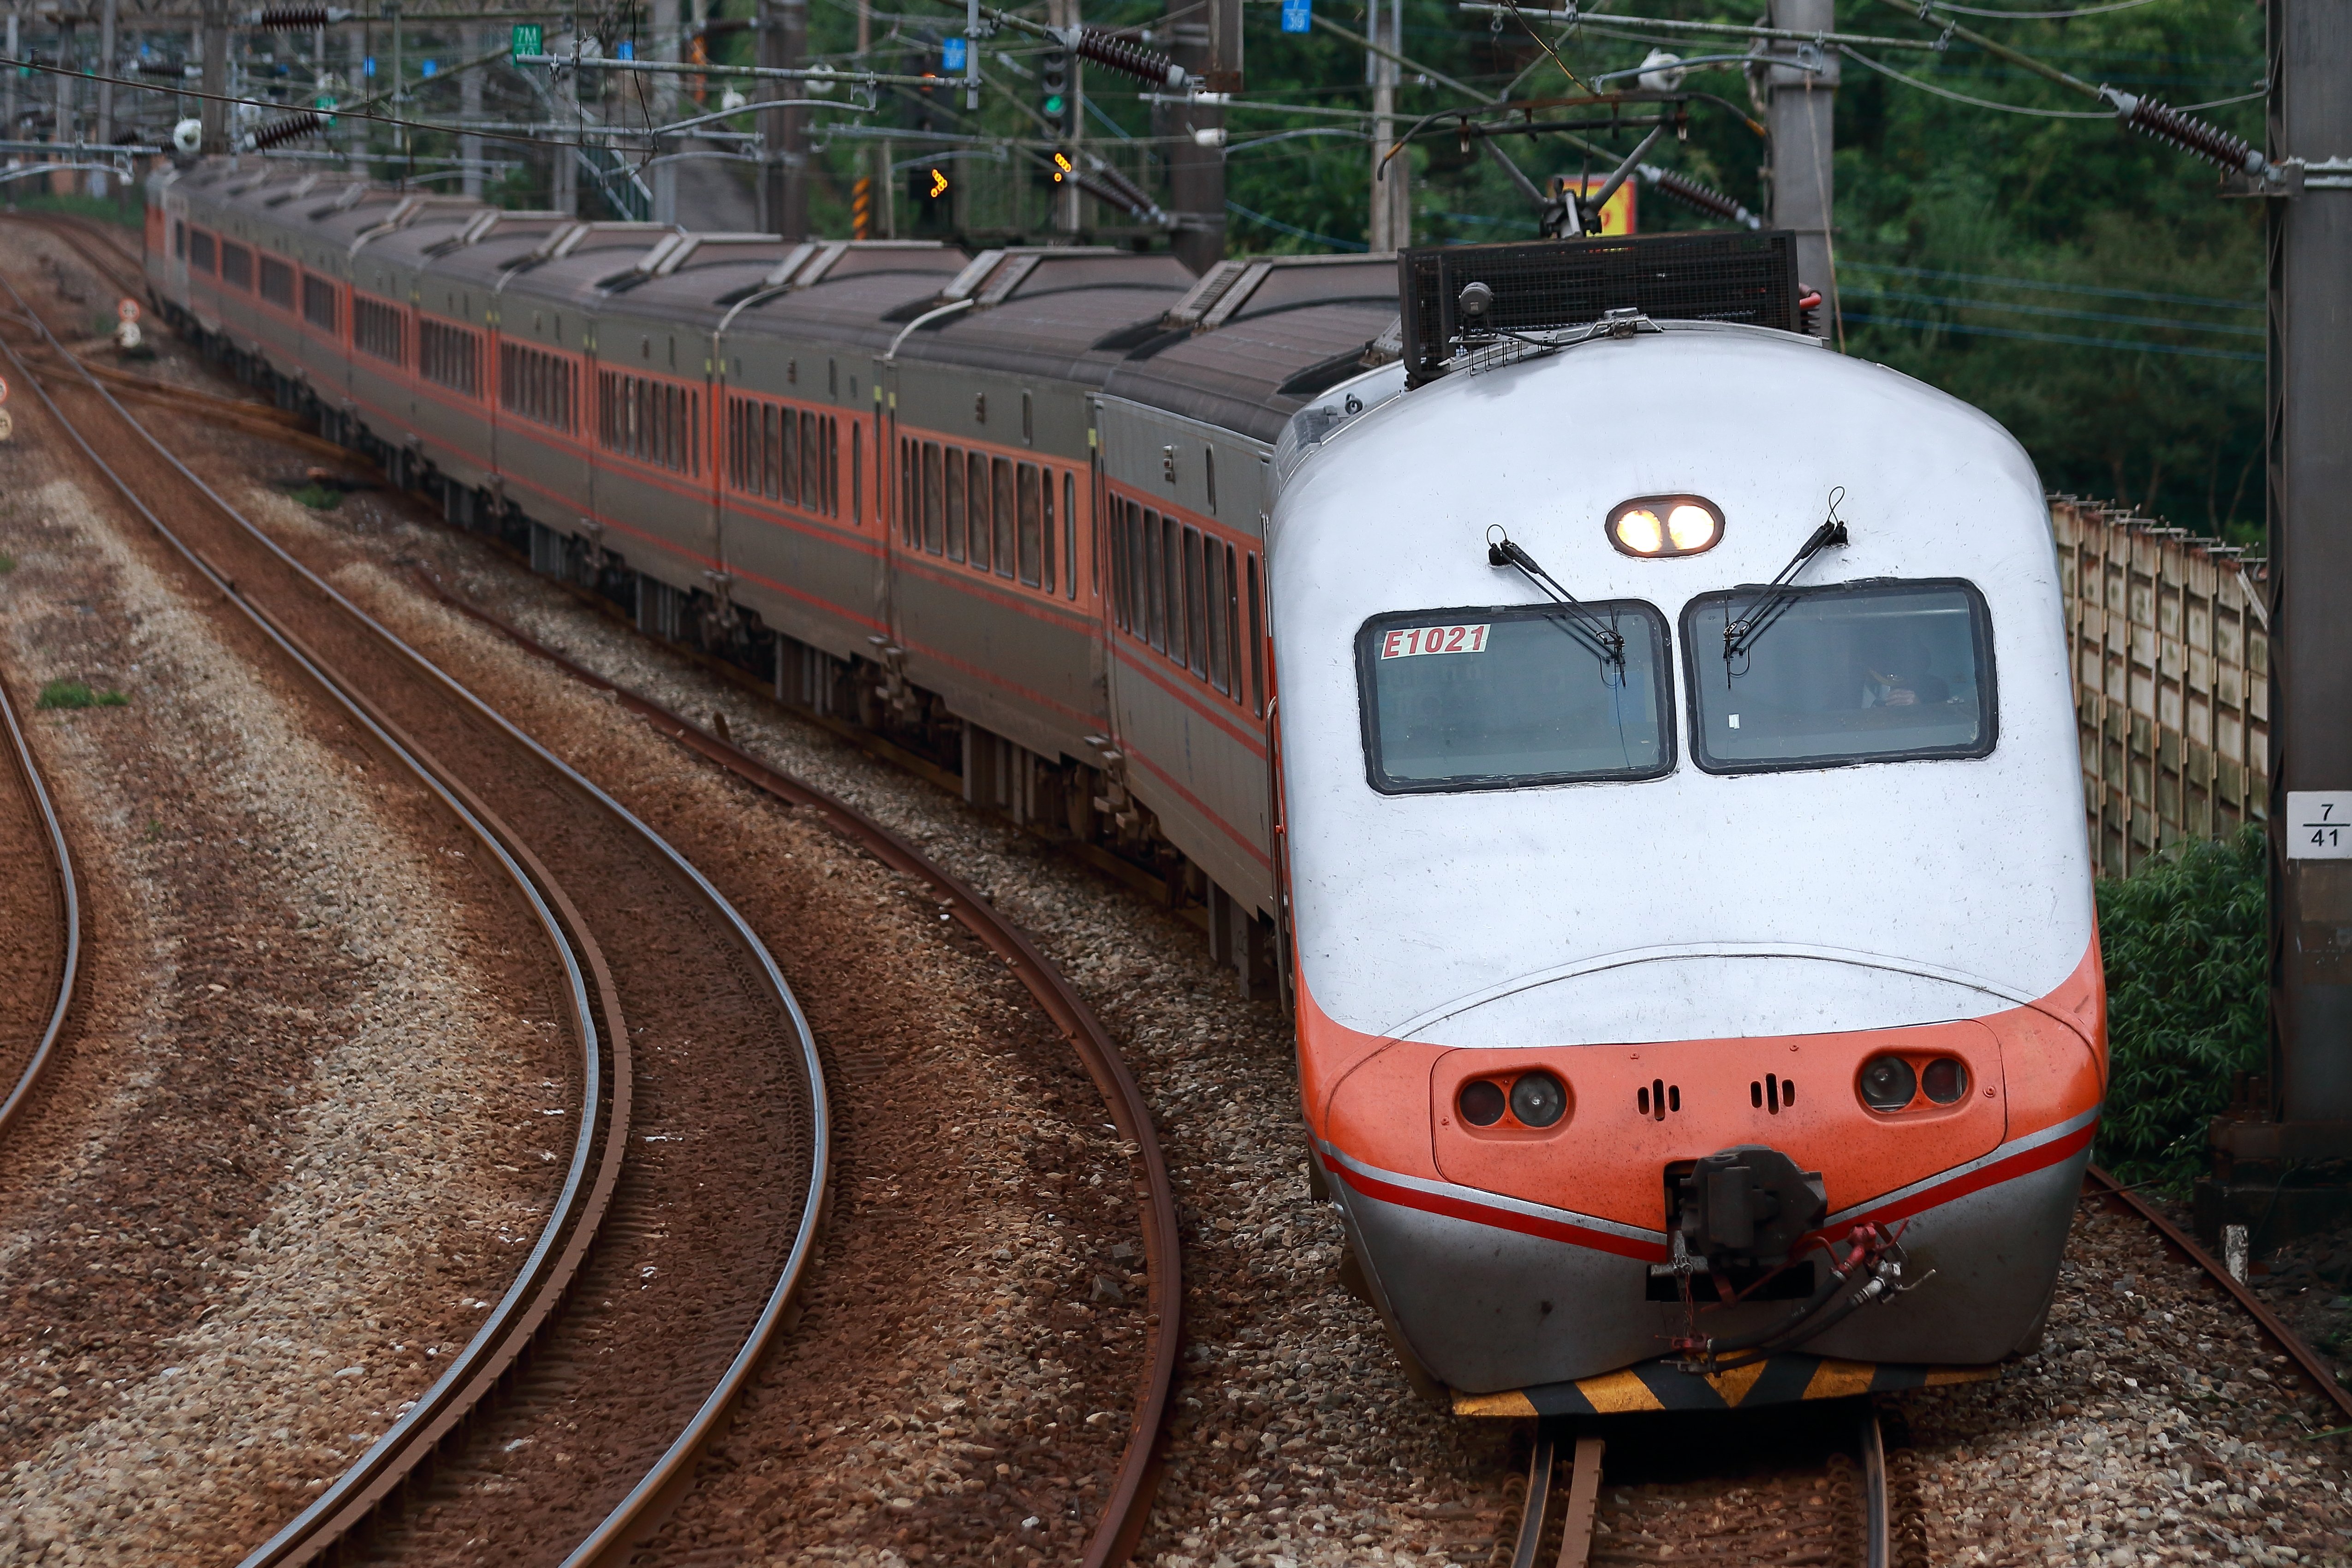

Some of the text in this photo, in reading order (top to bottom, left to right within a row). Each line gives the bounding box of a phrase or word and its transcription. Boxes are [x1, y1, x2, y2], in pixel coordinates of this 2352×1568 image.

[518, 27, 537, 44] 7M
[1384, 626, 1484, 657] E1021
[2321, 804, 2334, 821] 7
[2310, 829, 2338, 847] 41
